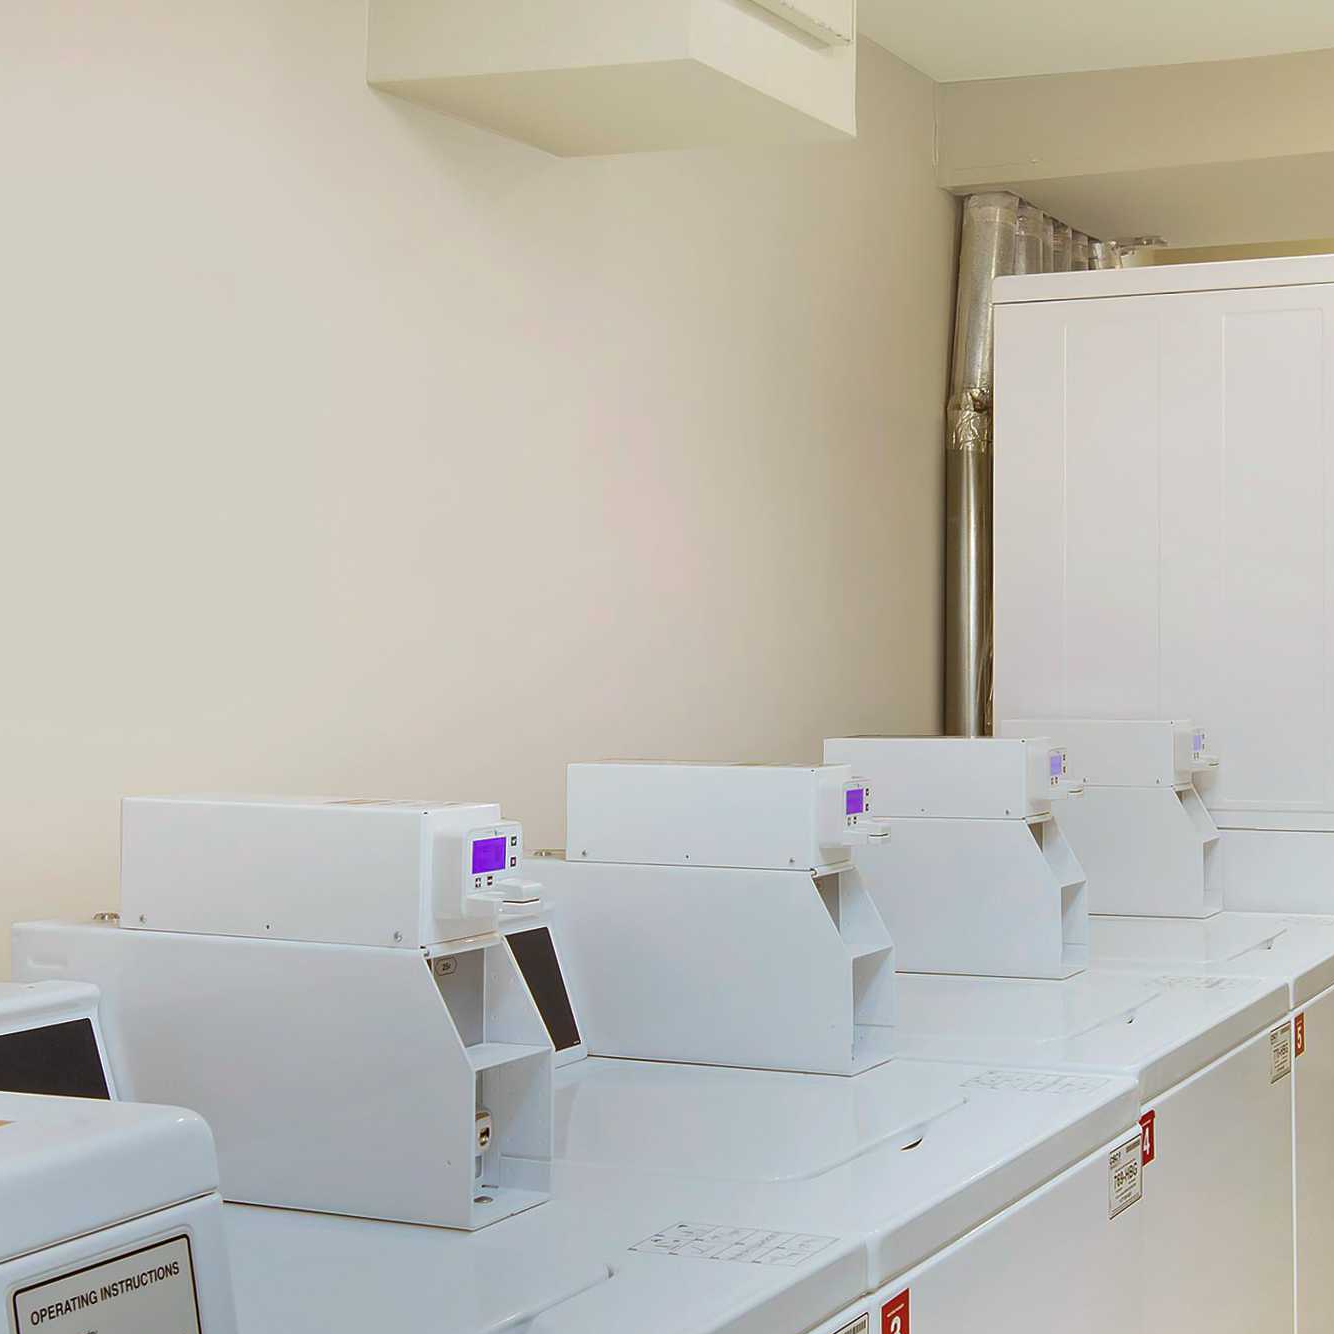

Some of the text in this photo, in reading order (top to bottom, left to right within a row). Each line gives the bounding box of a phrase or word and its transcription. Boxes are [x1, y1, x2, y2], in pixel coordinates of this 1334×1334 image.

[1297, 1026, 1302, 1049] 5
[1143, 1127, 1150, 1155] 4
[30, 1261, 180, 1325] OPERATING INSTRUCTIONS
